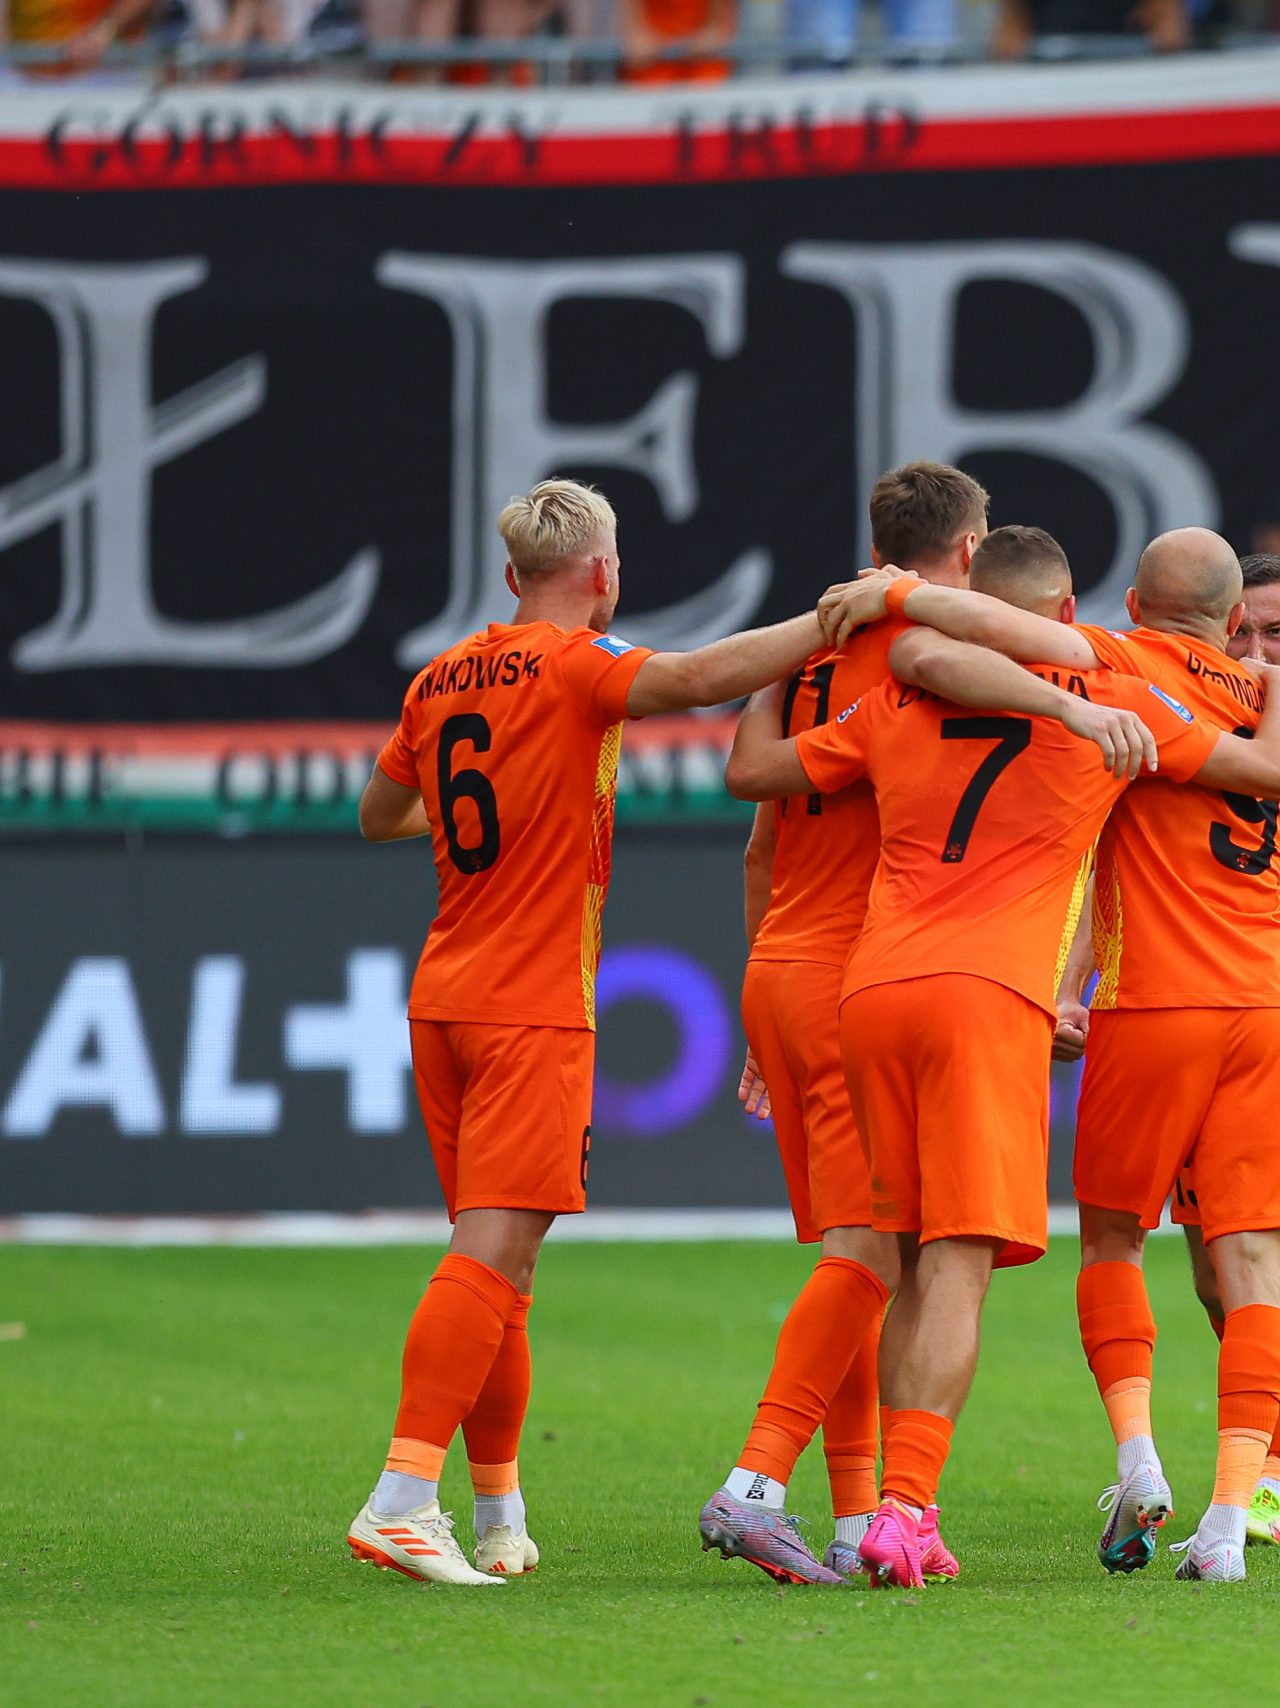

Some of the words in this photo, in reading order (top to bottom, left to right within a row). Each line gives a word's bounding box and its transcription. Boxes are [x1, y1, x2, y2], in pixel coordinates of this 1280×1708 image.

[650, 97, 922, 180] TRUD
[437, 713, 499, 875] 6
[941, 717, 1032, 864] 7
